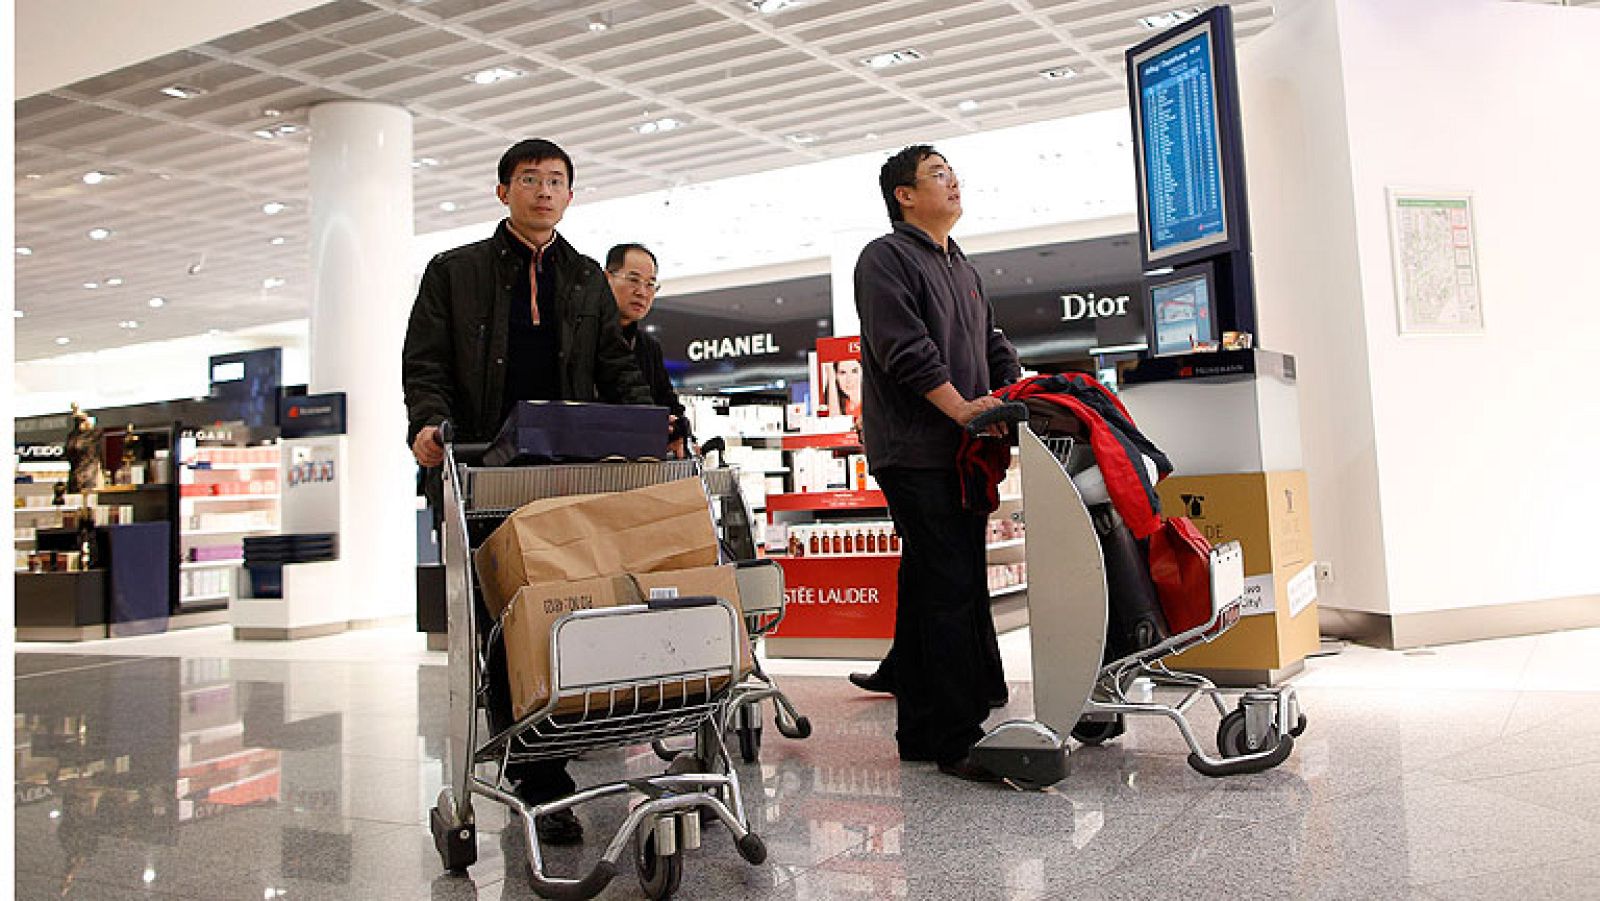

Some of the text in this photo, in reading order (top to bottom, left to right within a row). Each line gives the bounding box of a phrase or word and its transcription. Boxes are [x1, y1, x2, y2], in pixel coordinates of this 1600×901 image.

[1060, 292, 1130, 321] Dior
[687, 333, 780, 362] CHANEL
[783, 586, 880, 604] STÉE LAUDER
